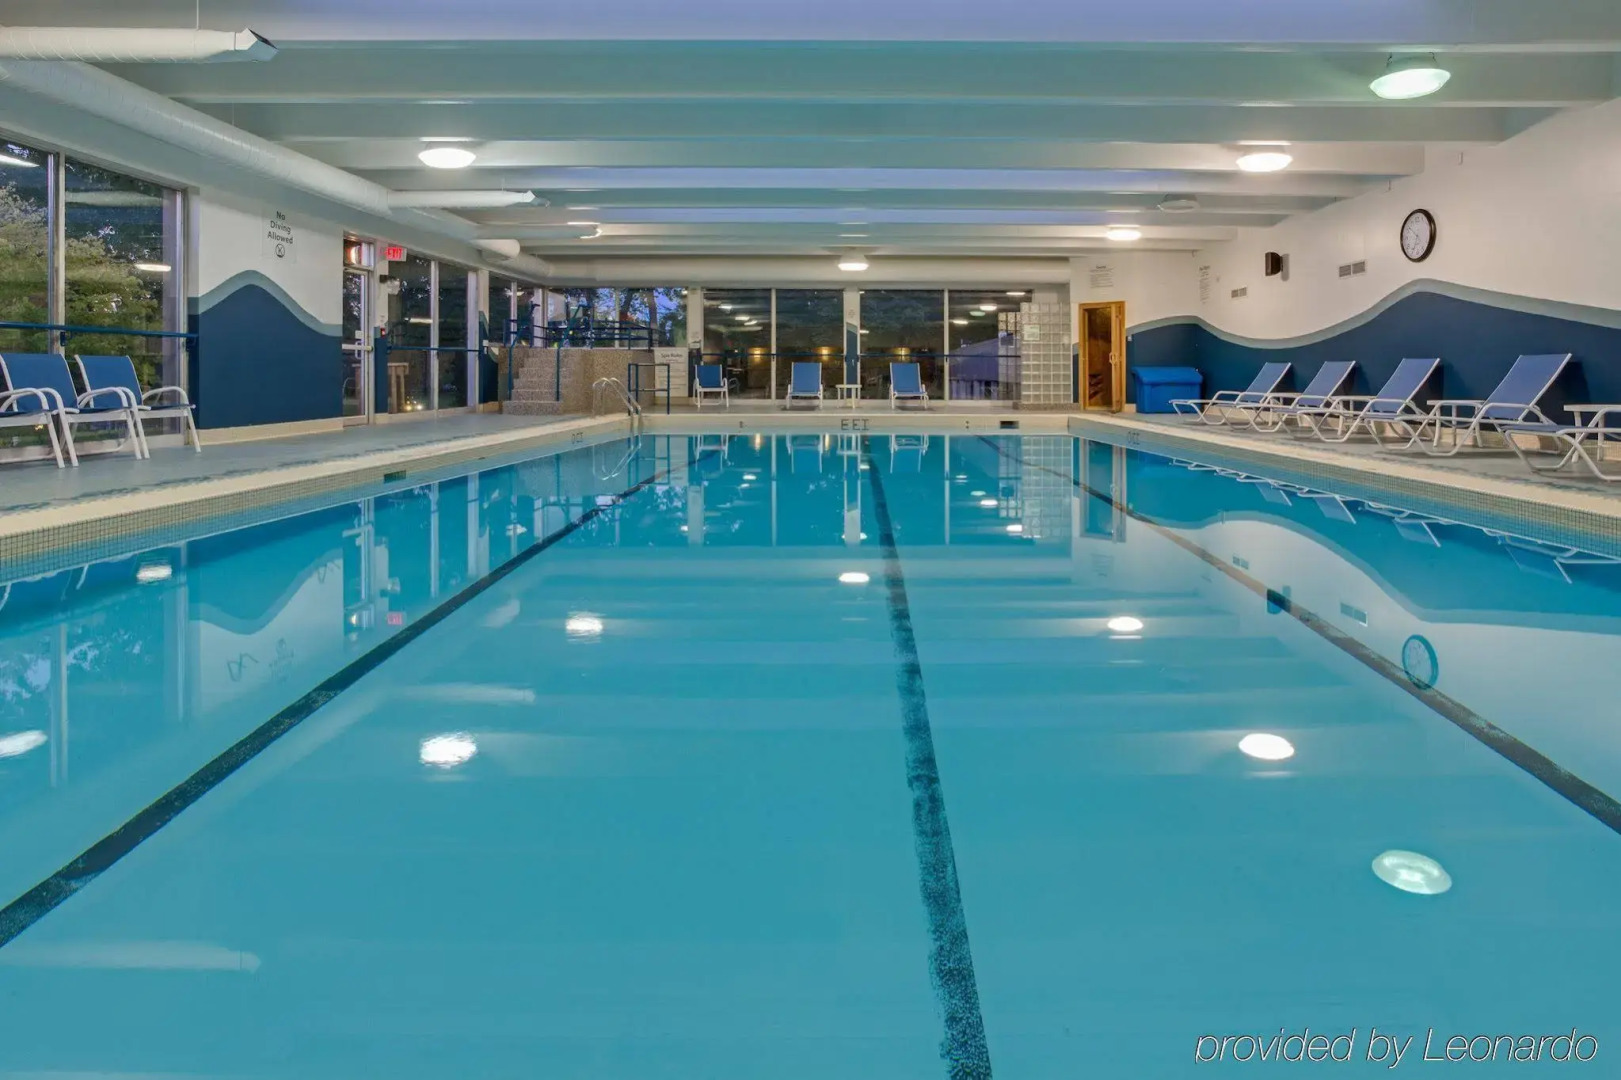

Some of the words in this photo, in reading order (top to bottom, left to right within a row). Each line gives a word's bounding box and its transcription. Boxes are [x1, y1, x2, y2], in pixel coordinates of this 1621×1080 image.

[276, 210, 286, 221] No
[270, 220, 291, 235] Diving
[267, 230, 294, 244] Allowed
[387, 246, 402, 260] EXIT
